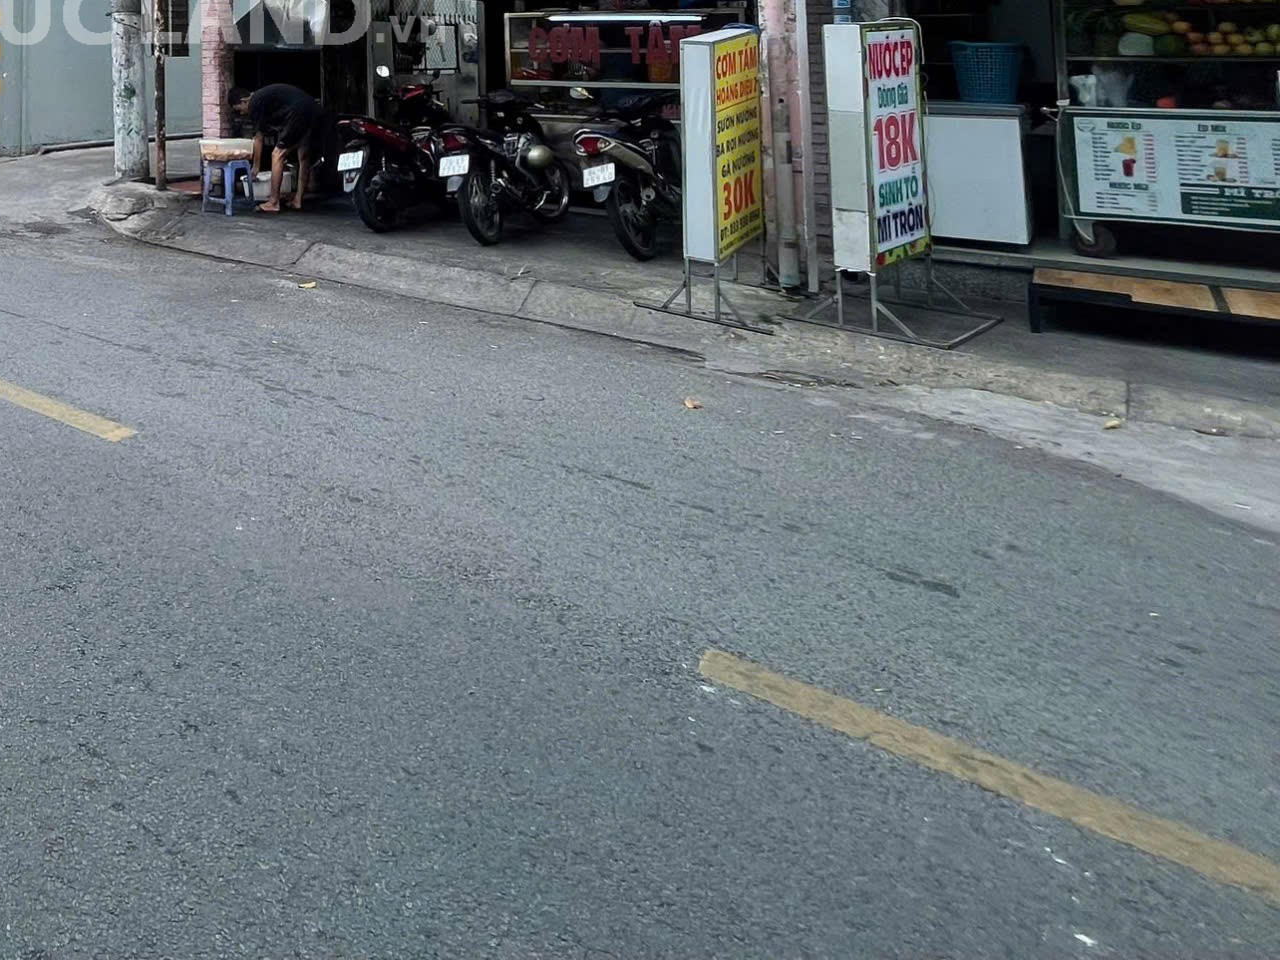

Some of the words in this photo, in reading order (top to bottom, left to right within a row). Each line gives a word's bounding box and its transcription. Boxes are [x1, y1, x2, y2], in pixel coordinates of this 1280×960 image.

[716, 49, 737, 80] CƠM
[868, 35, 899, 80] NƯỚC
[900, 34, 913, 77] ÉP
[874, 111, 918, 173] 18K
[722, 169, 756, 221] 30K
[879, 178, 903, 208] SINH
[904, 170, 918, 202] TỐ
[877, 210, 892, 244] MÌ
[892, 203, 923, 238] TRỘN
